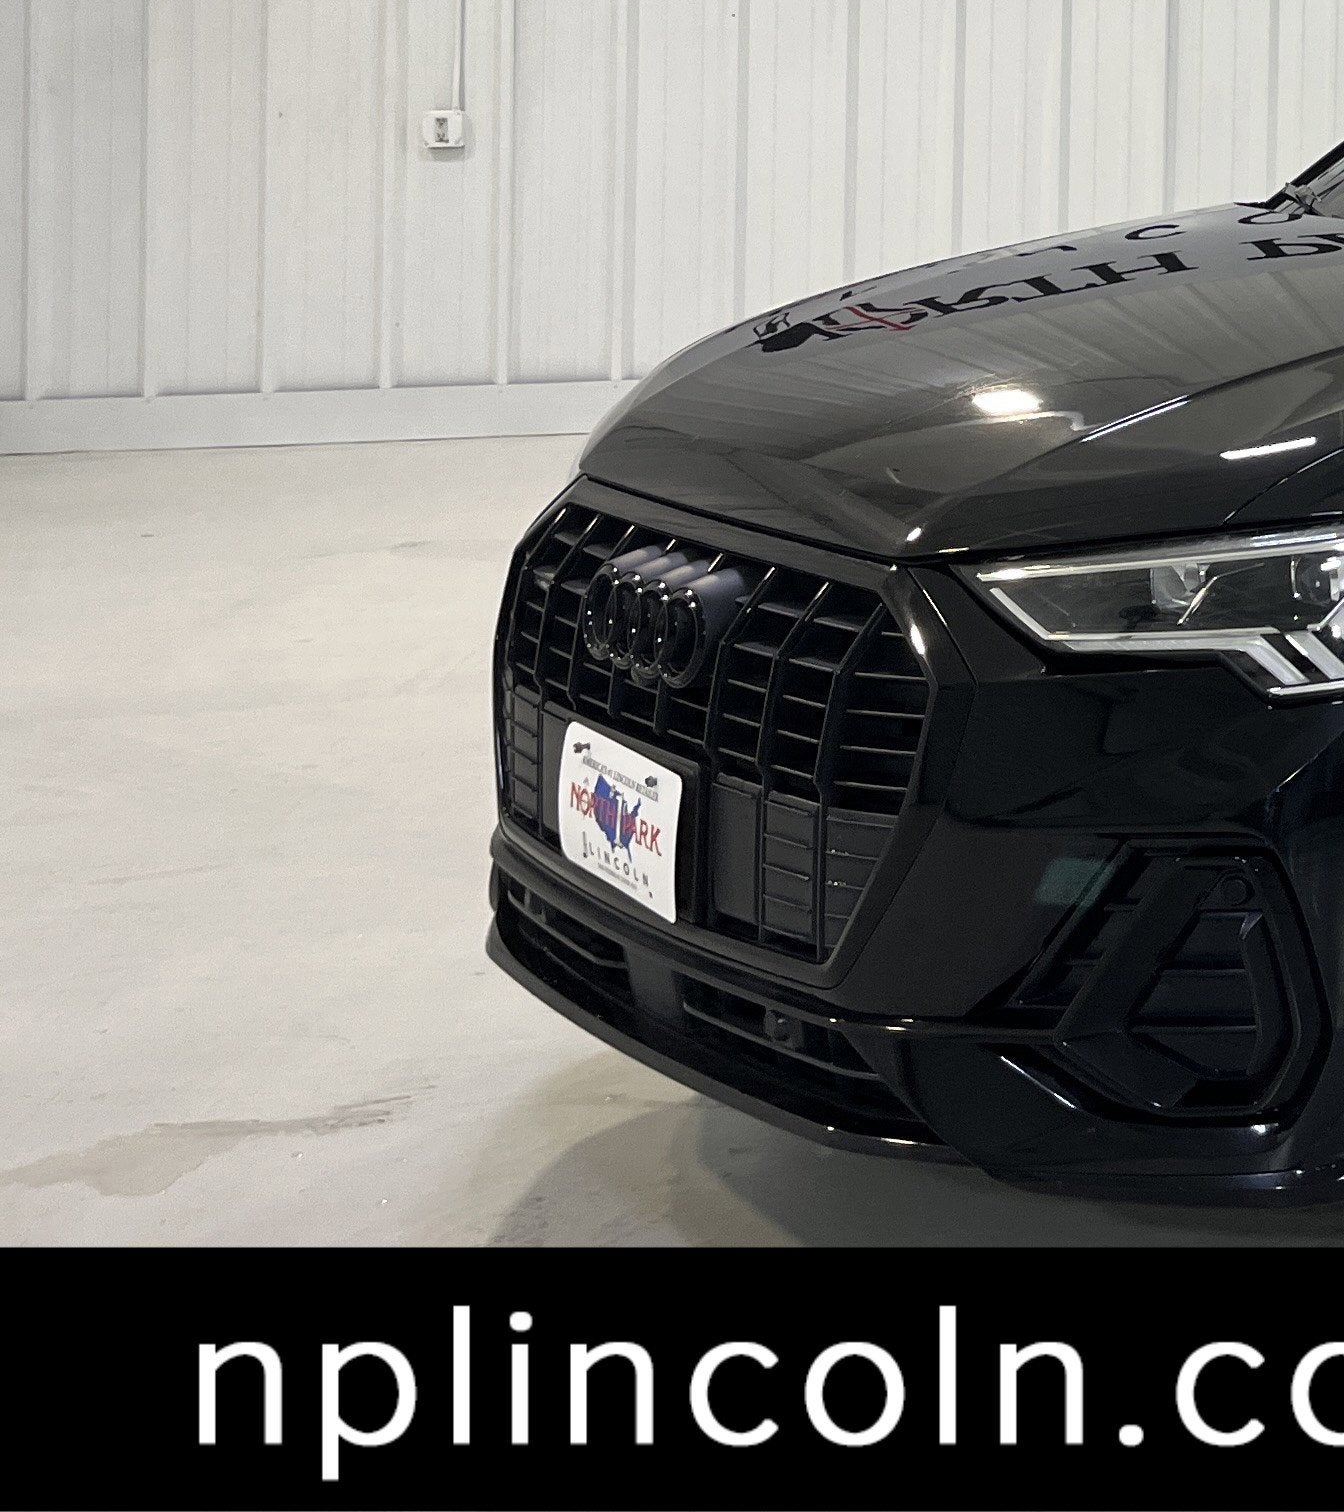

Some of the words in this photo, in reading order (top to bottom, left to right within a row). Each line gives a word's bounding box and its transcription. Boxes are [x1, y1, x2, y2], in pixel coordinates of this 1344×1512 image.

[569, 781, 617, 830] NORTH
[621, 810, 662, 857] PARK
[588, 841, 650, 887] LINCOLN
